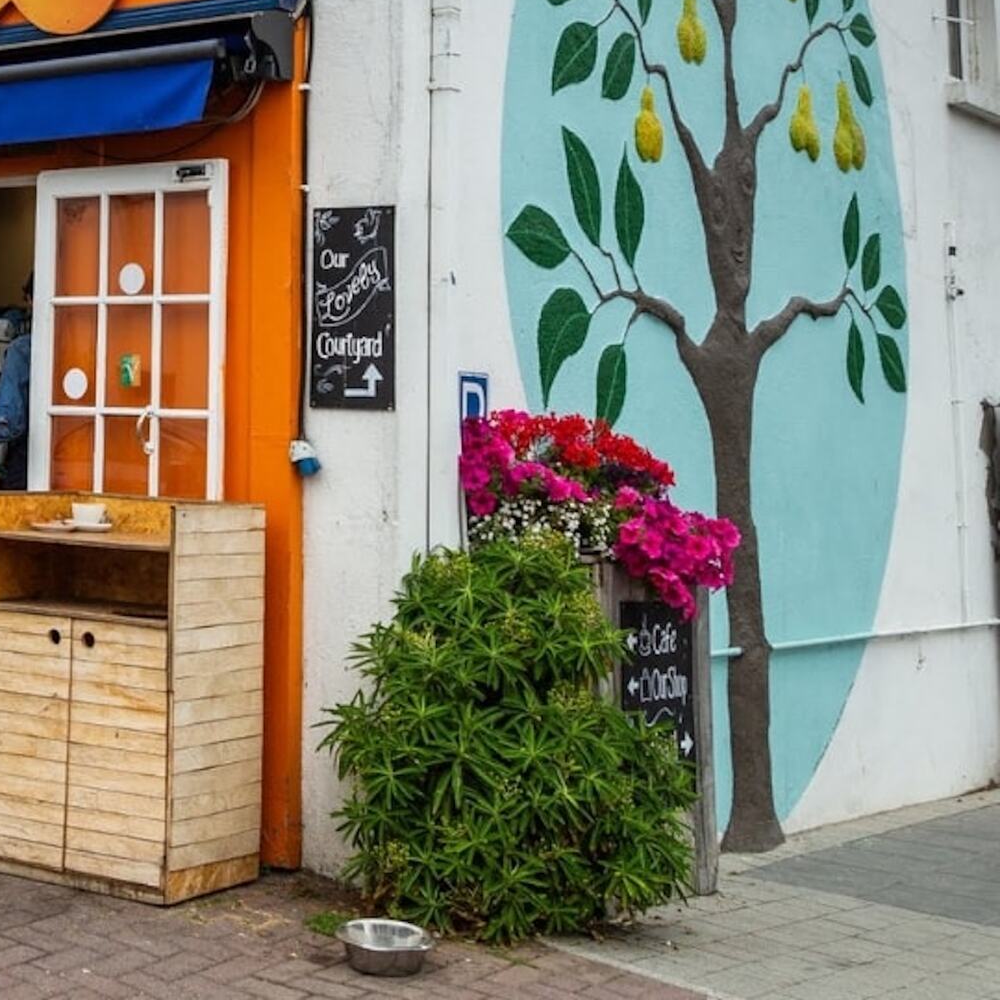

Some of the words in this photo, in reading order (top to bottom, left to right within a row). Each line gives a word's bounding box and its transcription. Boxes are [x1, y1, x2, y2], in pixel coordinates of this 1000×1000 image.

[320, 248, 350, 270] Our
[318, 259, 382, 322] Lovely
[316, 330, 383, 364] Courtyard
